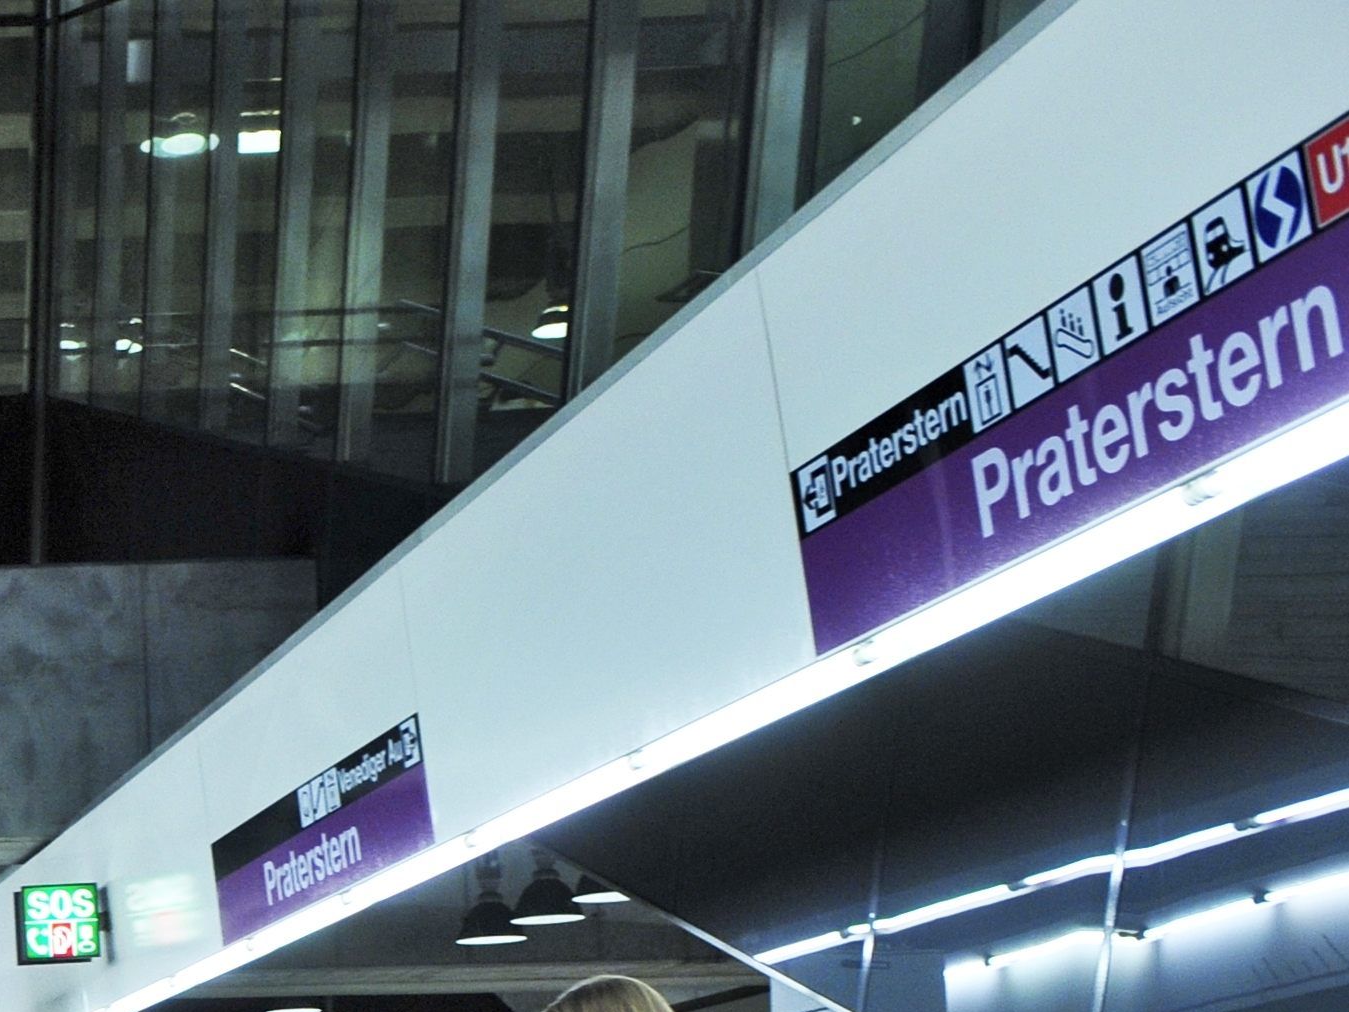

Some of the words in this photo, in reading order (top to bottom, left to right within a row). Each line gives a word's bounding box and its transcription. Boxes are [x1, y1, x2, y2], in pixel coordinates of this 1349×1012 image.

[831, 391, 968, 497] Praterstern
[971, 285, 1344, 538] Praterstern
[337, 749, 386, 793] Venediger
[27, 888, 96, 920] SOS
[263, 826, 362, 906] Praterstern
